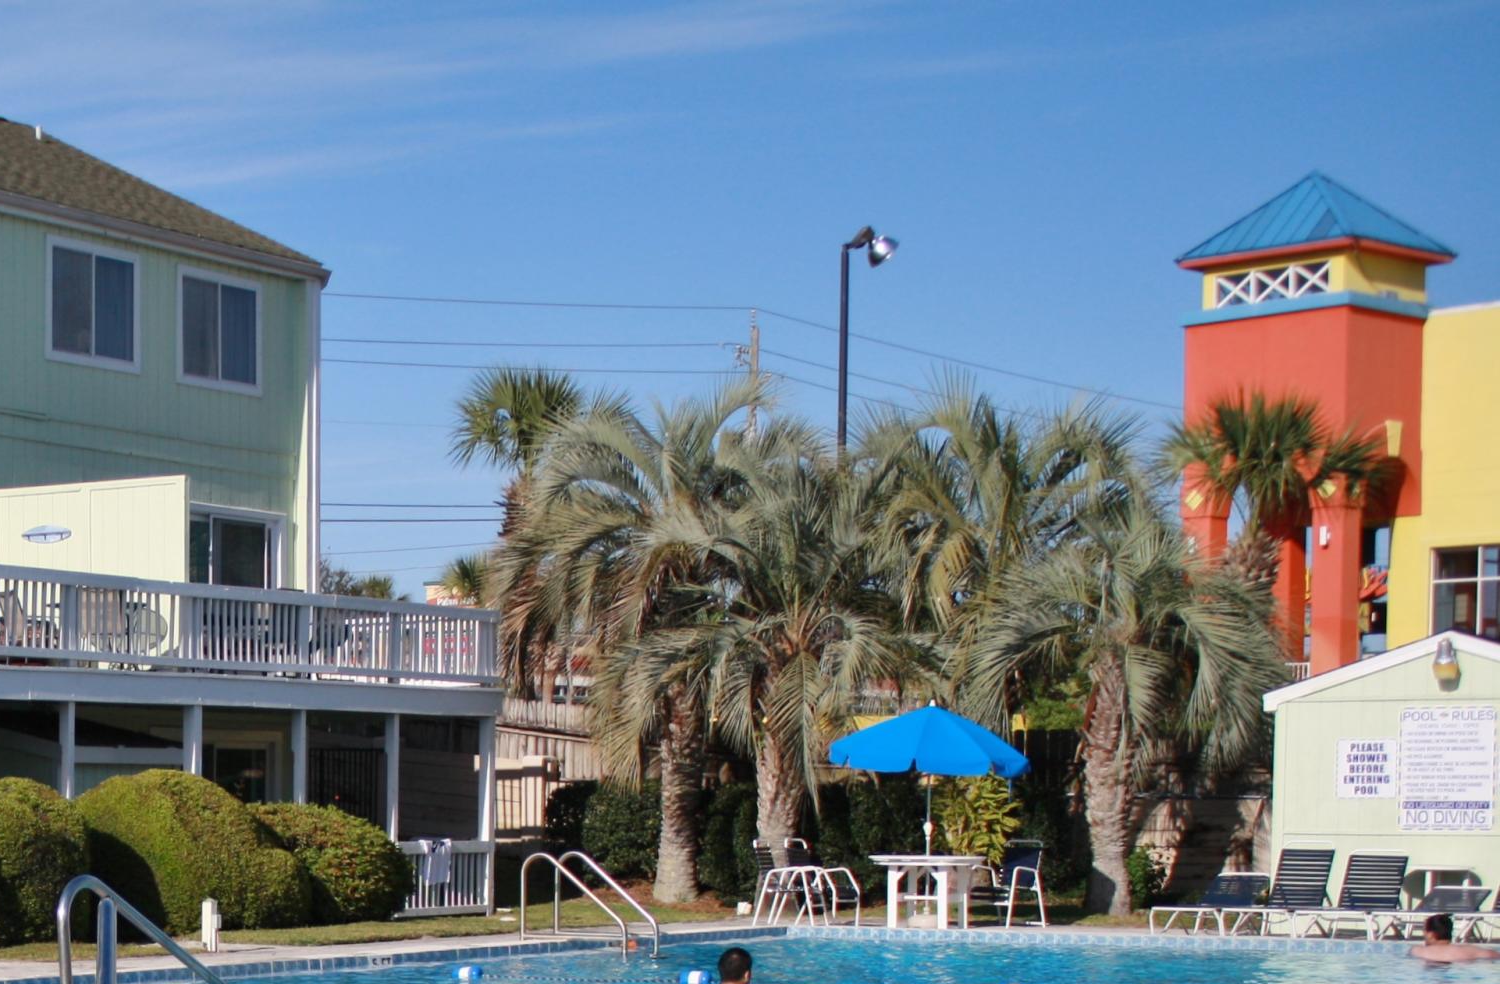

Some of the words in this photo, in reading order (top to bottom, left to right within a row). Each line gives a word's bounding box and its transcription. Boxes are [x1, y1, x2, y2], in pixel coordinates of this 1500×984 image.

[1403, 711, 1438, 721] POOL
[1451, 710, 1494, 721] RULES
[1350, 743, 1385, 752] PLEASE
[1346, 754, 1388, 763] SHOWER
[1349, 764, 1385, 773] BEFORE
[1343, 775, 1390, 784] ENTERING
[1354, 785, 1379, 795] POOL
[1406, 810, 1428, 823] NO
[1433, 810, 1486, 824] DIVING
